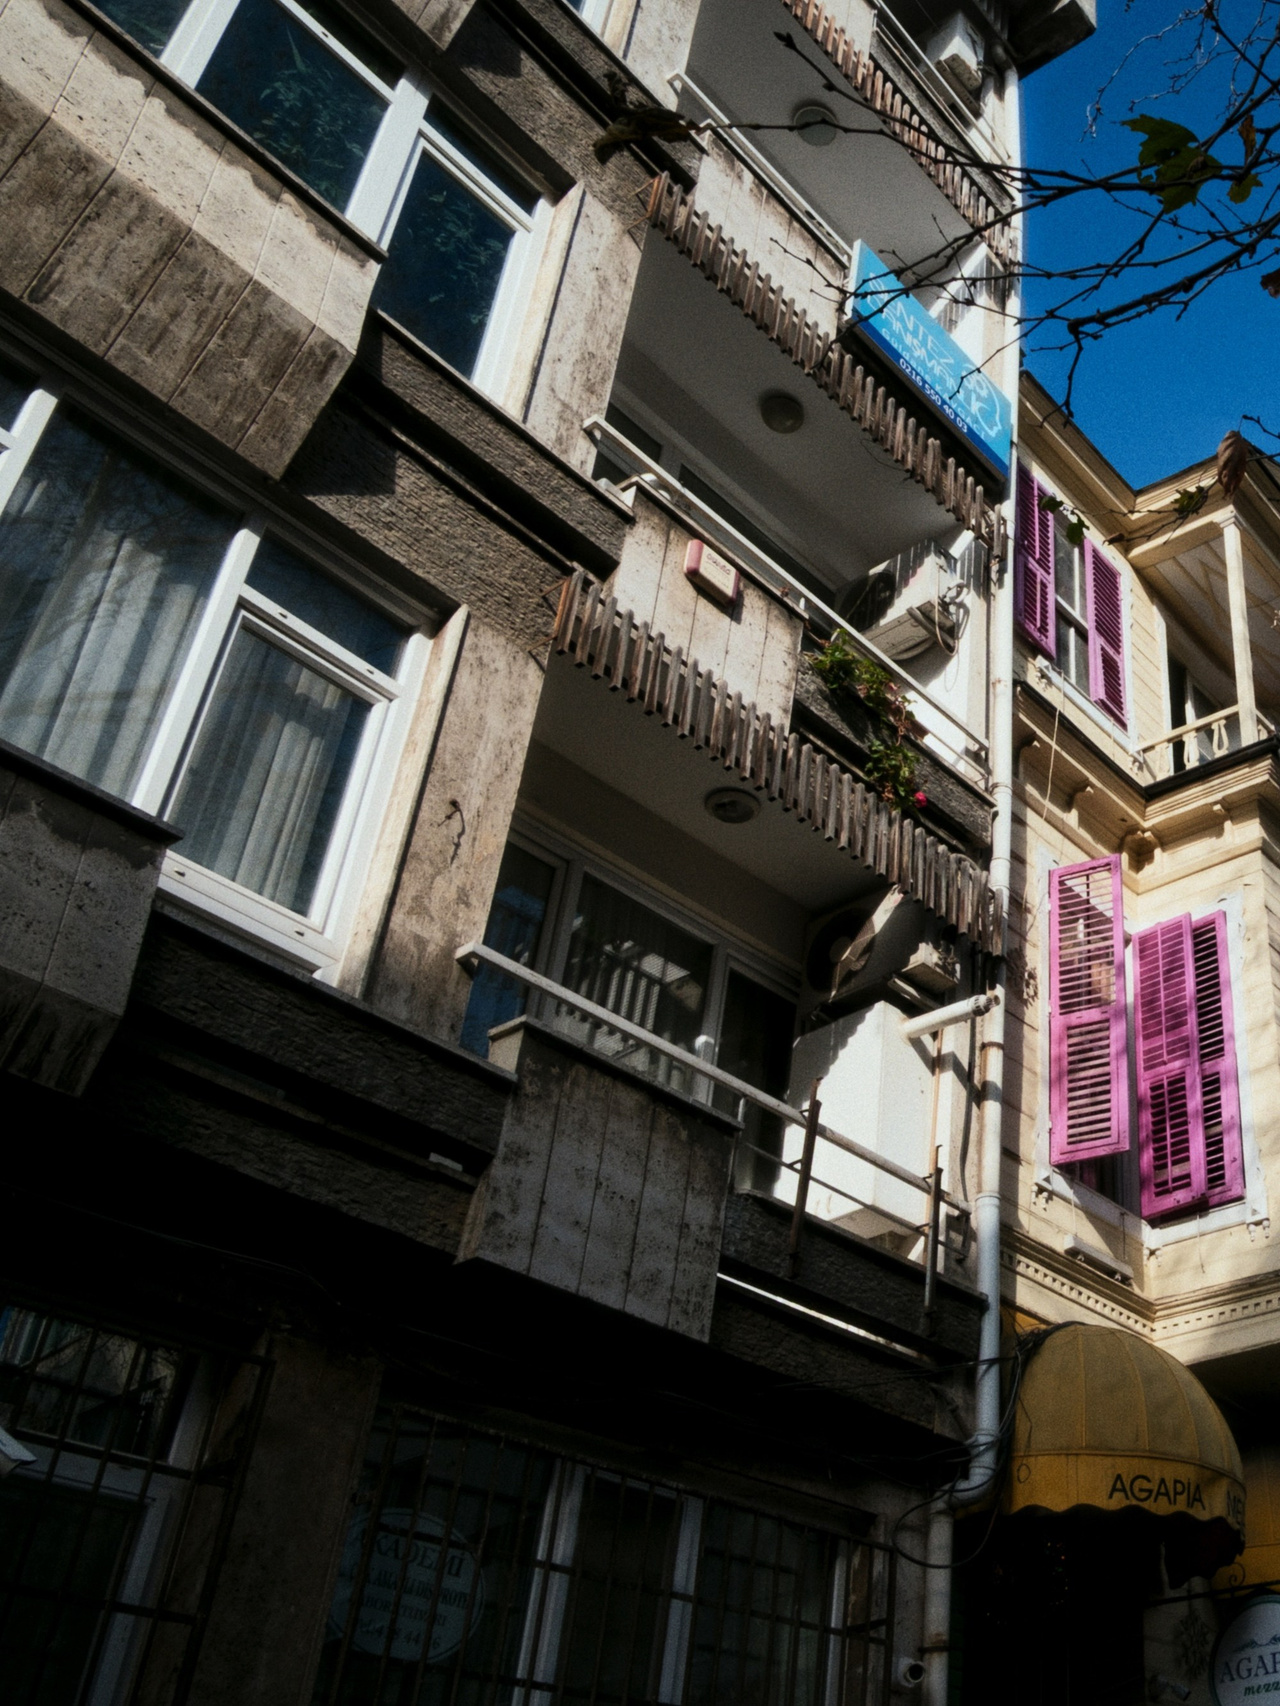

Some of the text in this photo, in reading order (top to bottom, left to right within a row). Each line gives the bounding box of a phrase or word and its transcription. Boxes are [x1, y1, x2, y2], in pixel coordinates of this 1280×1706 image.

[868, 268, 954, 376] SENTEZ
[899, 356, 967, 433] 0216 550 40 03
